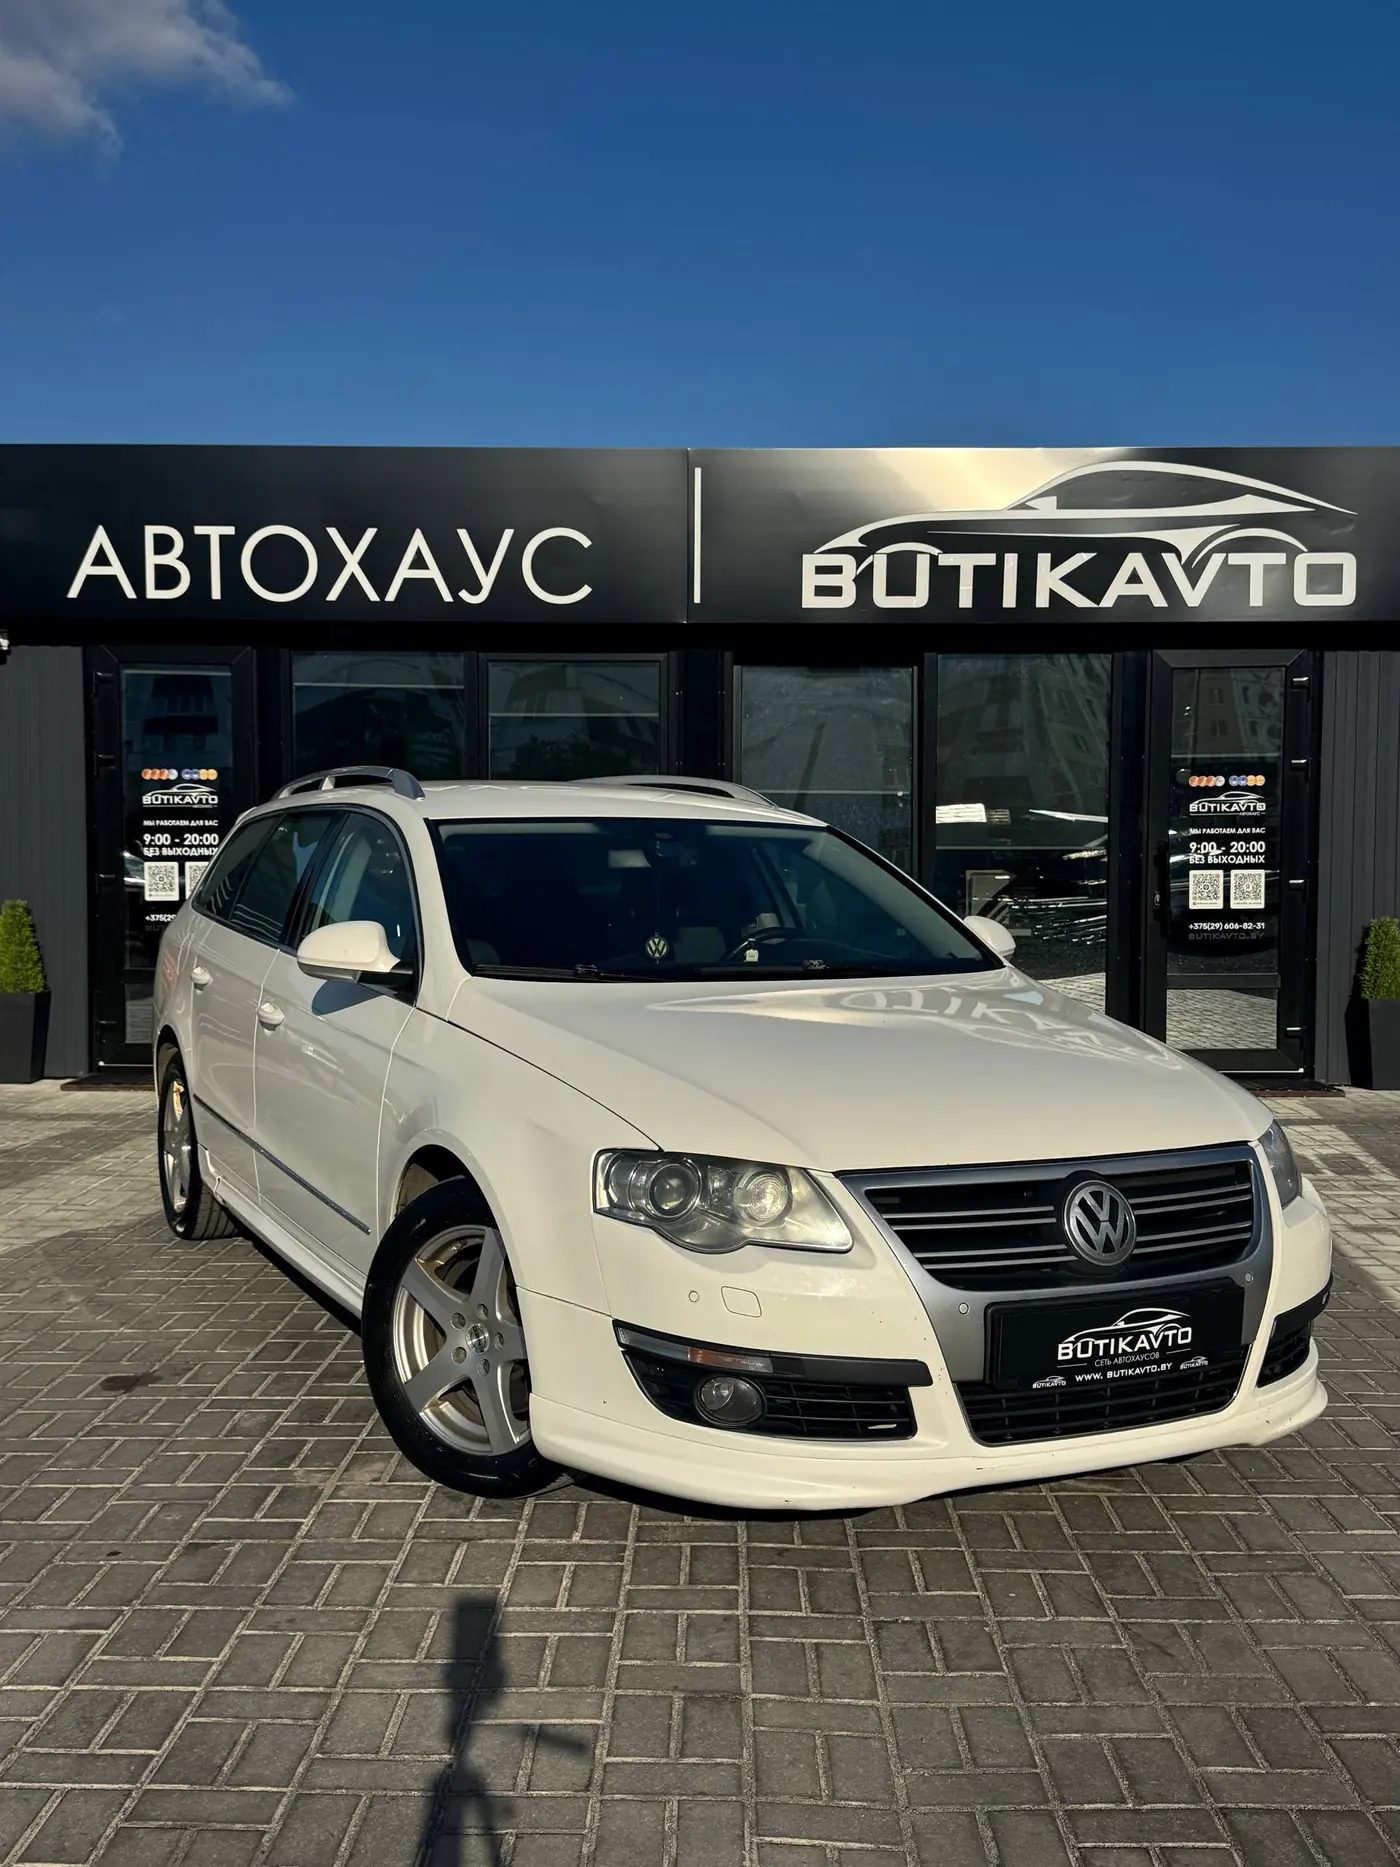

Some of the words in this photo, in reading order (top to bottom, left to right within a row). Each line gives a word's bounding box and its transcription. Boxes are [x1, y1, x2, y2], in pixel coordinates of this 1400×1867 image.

[68, 525, 592, 604] АВТОХАУС
[802, 552, 1357, 609] BUTIKAVTO
[142, 794, 218, 804] BUTIKAVTO
[1189, 802, 1266, 812] BUTIKAVTO
[143, 834, 171, 845] 9:00
[183, 834, 219, 845] 20:00
[143, 847, 160, 856] БЕЗ
[1189, 842, 1217, 853] 9:00
[1230, 841, 1266, 852] 20:00
[1189, 856, 1205, 864] БЕЗ
[1207, 855, 1266, 864] ВЫХОДНЫХ
[1188, 923, 1223, 931] +375(29)
[1224, 922, 1266, 930] 606-82-31
[1057, 1327, 1192, 1360] BUTIKAVTO
[1094, 1358, 1112, 1367] СЕТЬ
[1113, 1352, 1160, 1364] АВТОХАУСОВ
[1106, 1362, 1172, 1379] BUTIKAVTO.BY
